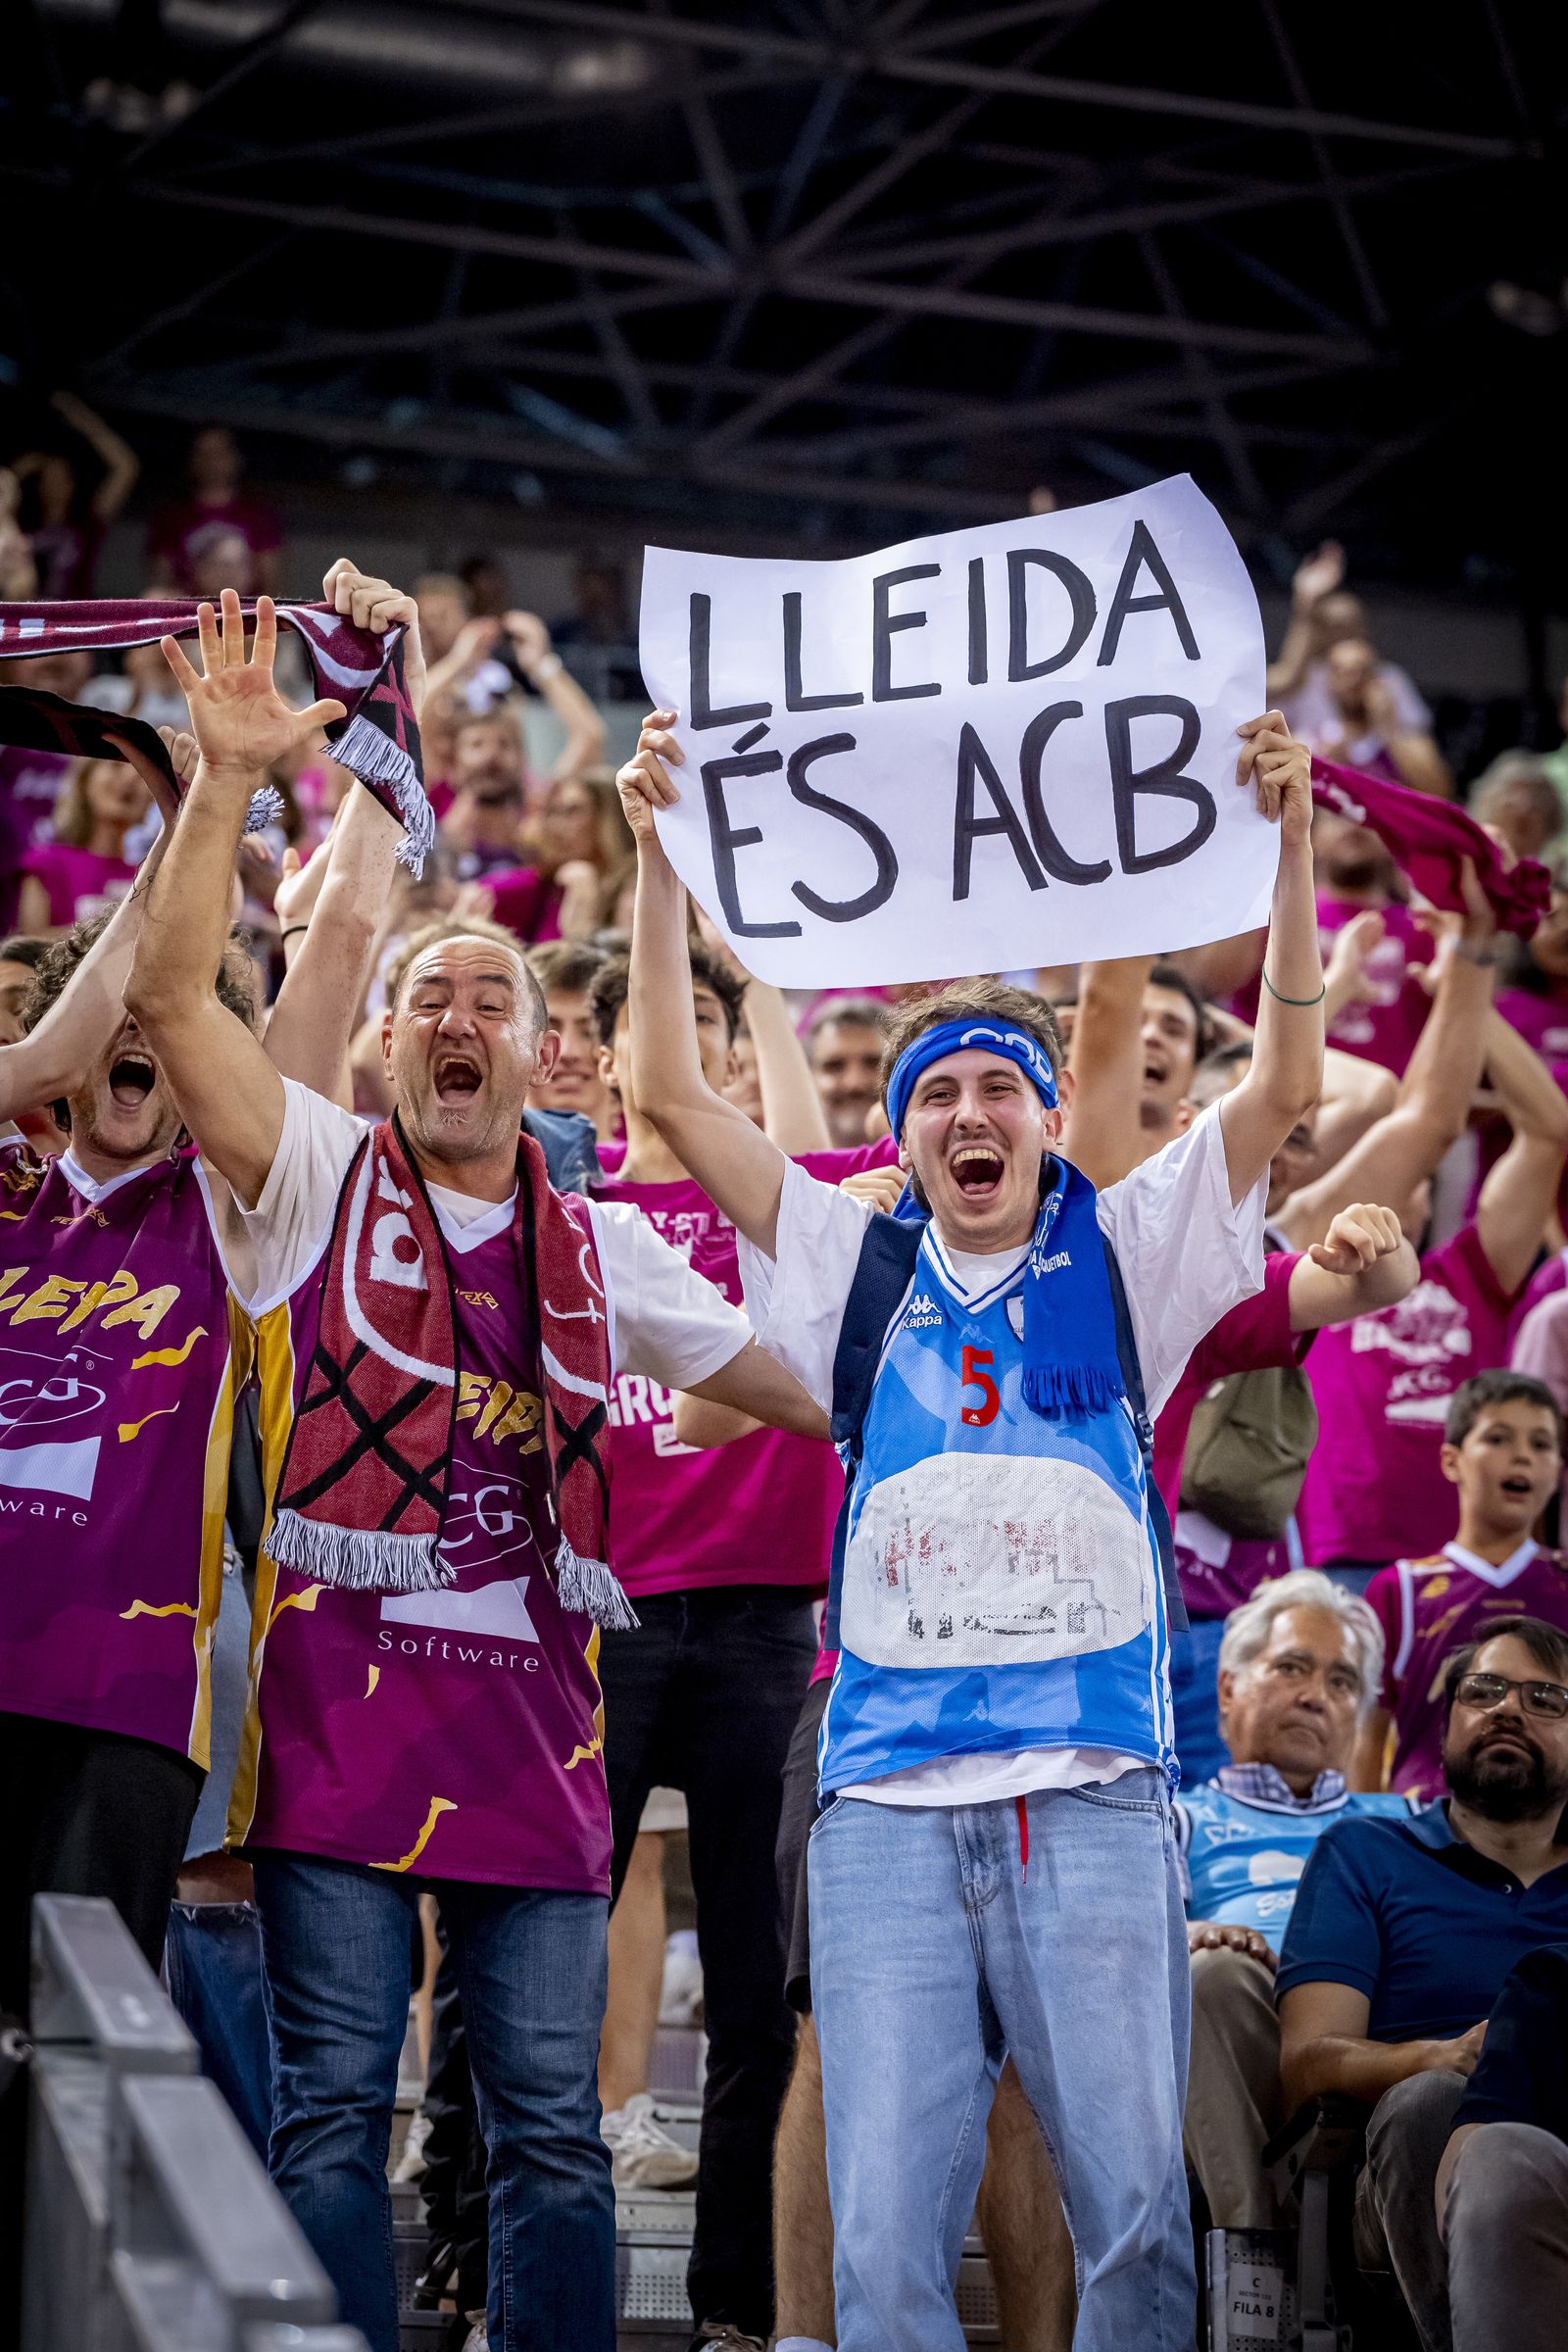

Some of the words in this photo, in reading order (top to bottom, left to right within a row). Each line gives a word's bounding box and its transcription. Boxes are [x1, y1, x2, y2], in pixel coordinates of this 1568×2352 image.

[690, 519, 1200, 730] LLEIDA
[700, 722, 899, 937] ÉS
[954, 695, 1216, 902] ACB
[902, 1314, 943, 1331] Kappa
[961, 1345, 1001, 1428] 5
[377, 1630, 539, 1672] Software
[1252, 2277, 1261, 2288] C
[1233, 2301, 1262, 2317] FILA
[1265, 2306, 1275, 2319] 8
